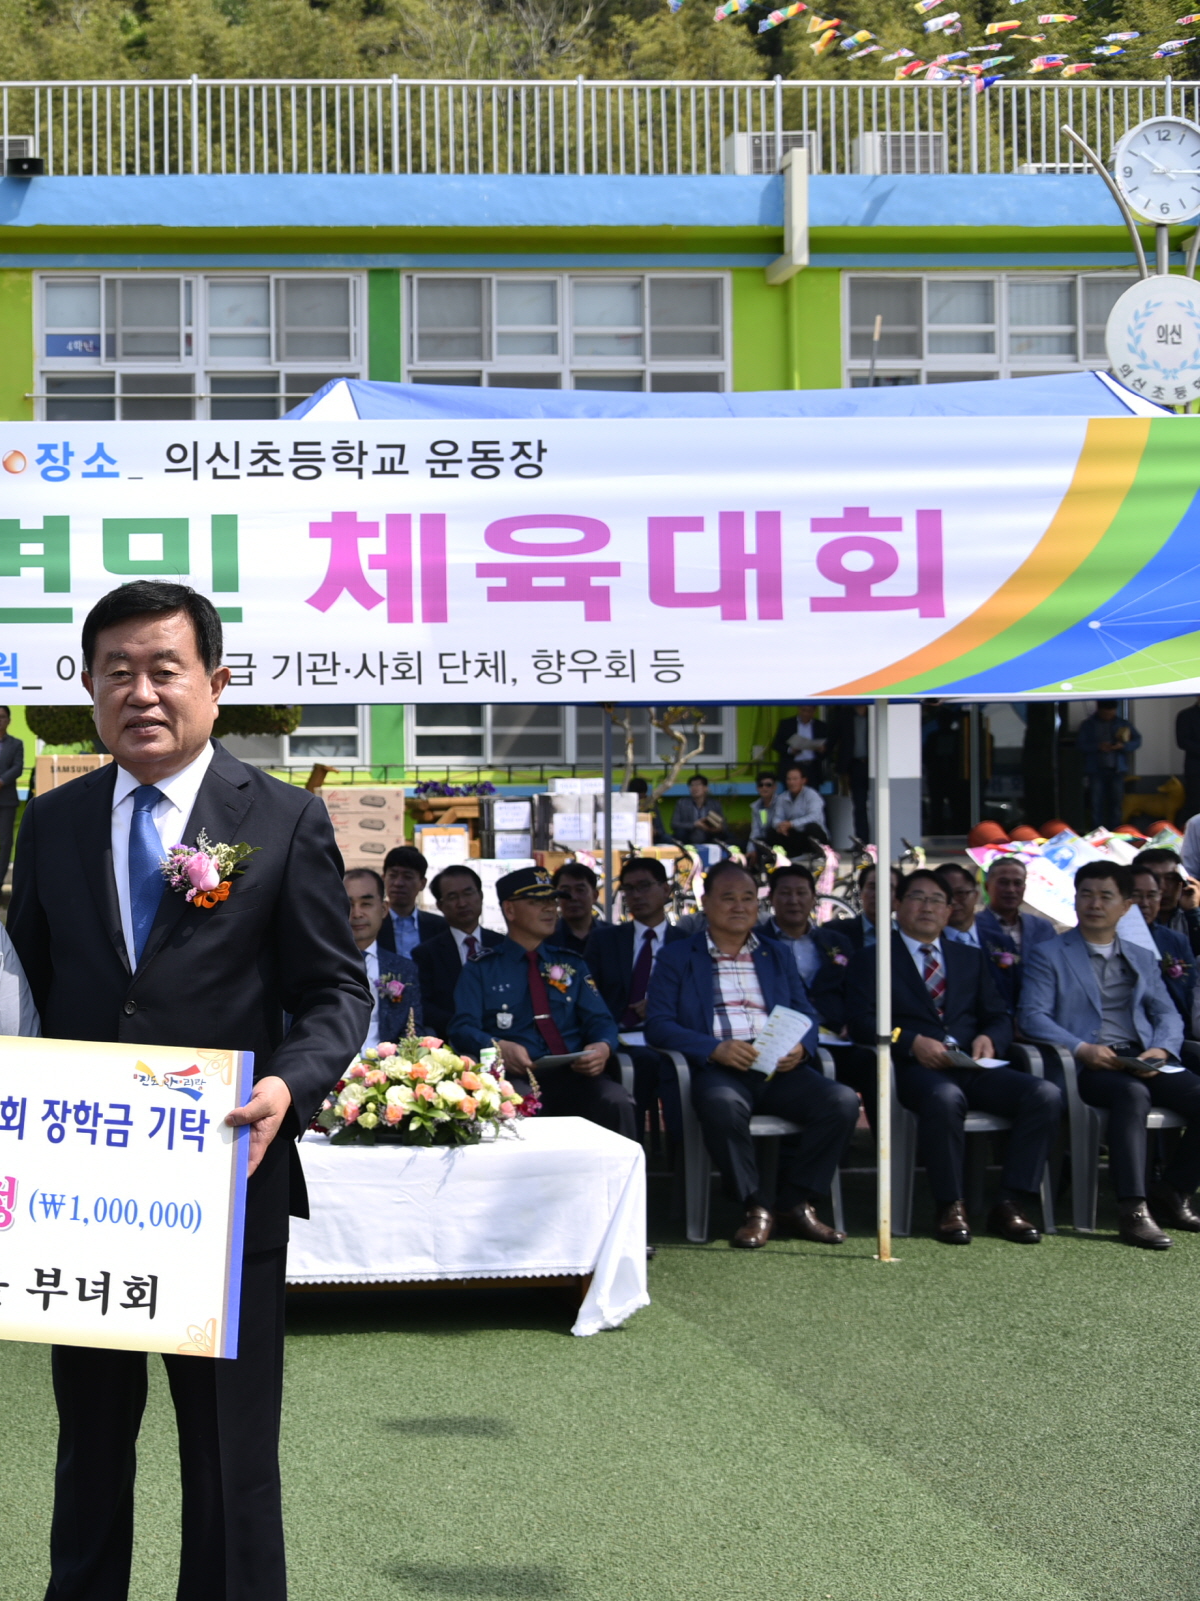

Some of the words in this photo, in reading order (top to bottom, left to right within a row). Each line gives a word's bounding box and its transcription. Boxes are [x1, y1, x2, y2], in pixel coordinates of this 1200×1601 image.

[1155, 129, 1171, 141] 12
[1123, 166, 1133, 178] 9
[1160, 203, 1170, 214] 6
[1156, 323, 1183, 345] 의신
[165, 440, 410, 481] 의신초등학교
[429, 439, 547, 480] 운동장
[305, 507, 946, 625] 체육대회
[438, 650, 518, 687] 단체,
[532, 649, 636, 684] 향우회
[650, 649, 685, 683] 등
[41, 1099, 134, 1148] 장학금
[148, 1106, 211, 1153] 기탁
[25, 1267, 159, 1320] 부녀회
